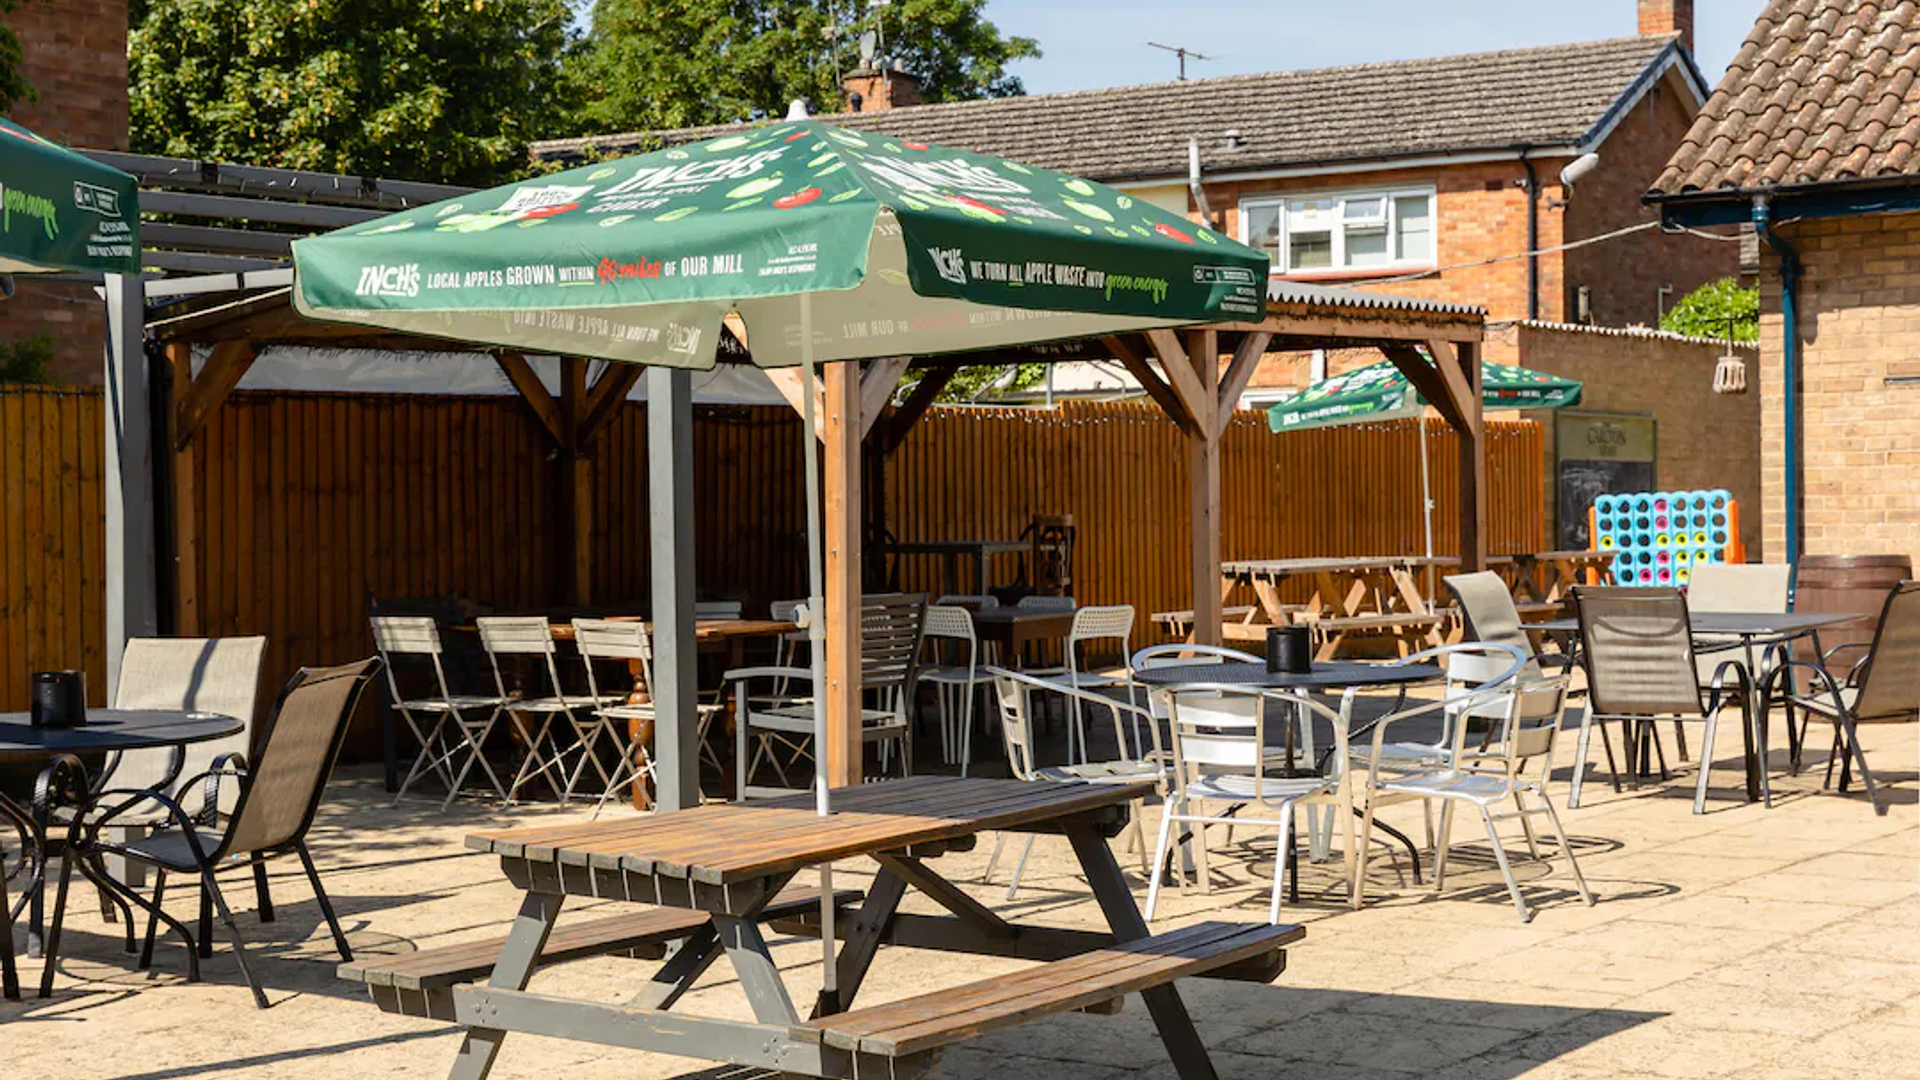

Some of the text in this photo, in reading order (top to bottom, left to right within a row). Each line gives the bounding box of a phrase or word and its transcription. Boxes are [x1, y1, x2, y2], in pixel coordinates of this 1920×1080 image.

[594, 146, 791, 196] INCH'S
[356, 262, 421, 297] INCH'S
[427, 272, 461, 289] LOCAL
[464, 270, 503, 288] APPLES
[506, 264, 555, 286] GROWN
[558, 266, 595, 282] WITHIN
[664, 260, 678, 277] OF
[681, 257, 708, 277] OUR
[712, 254, 744, 274] MILL
[970, 261, 983, 279] WE
[984, 262, 1007, 281] TURN
[1009, 264, 1023, 282] ALL
[1025, 262, 1053, 284] APPLE
[1054, 264, 1086, 287] WASTE
[1086, 270, 1105, 288] INTO
[1105, 274, 1132, 301] green
[1133, 277, 1168, 304] energy
